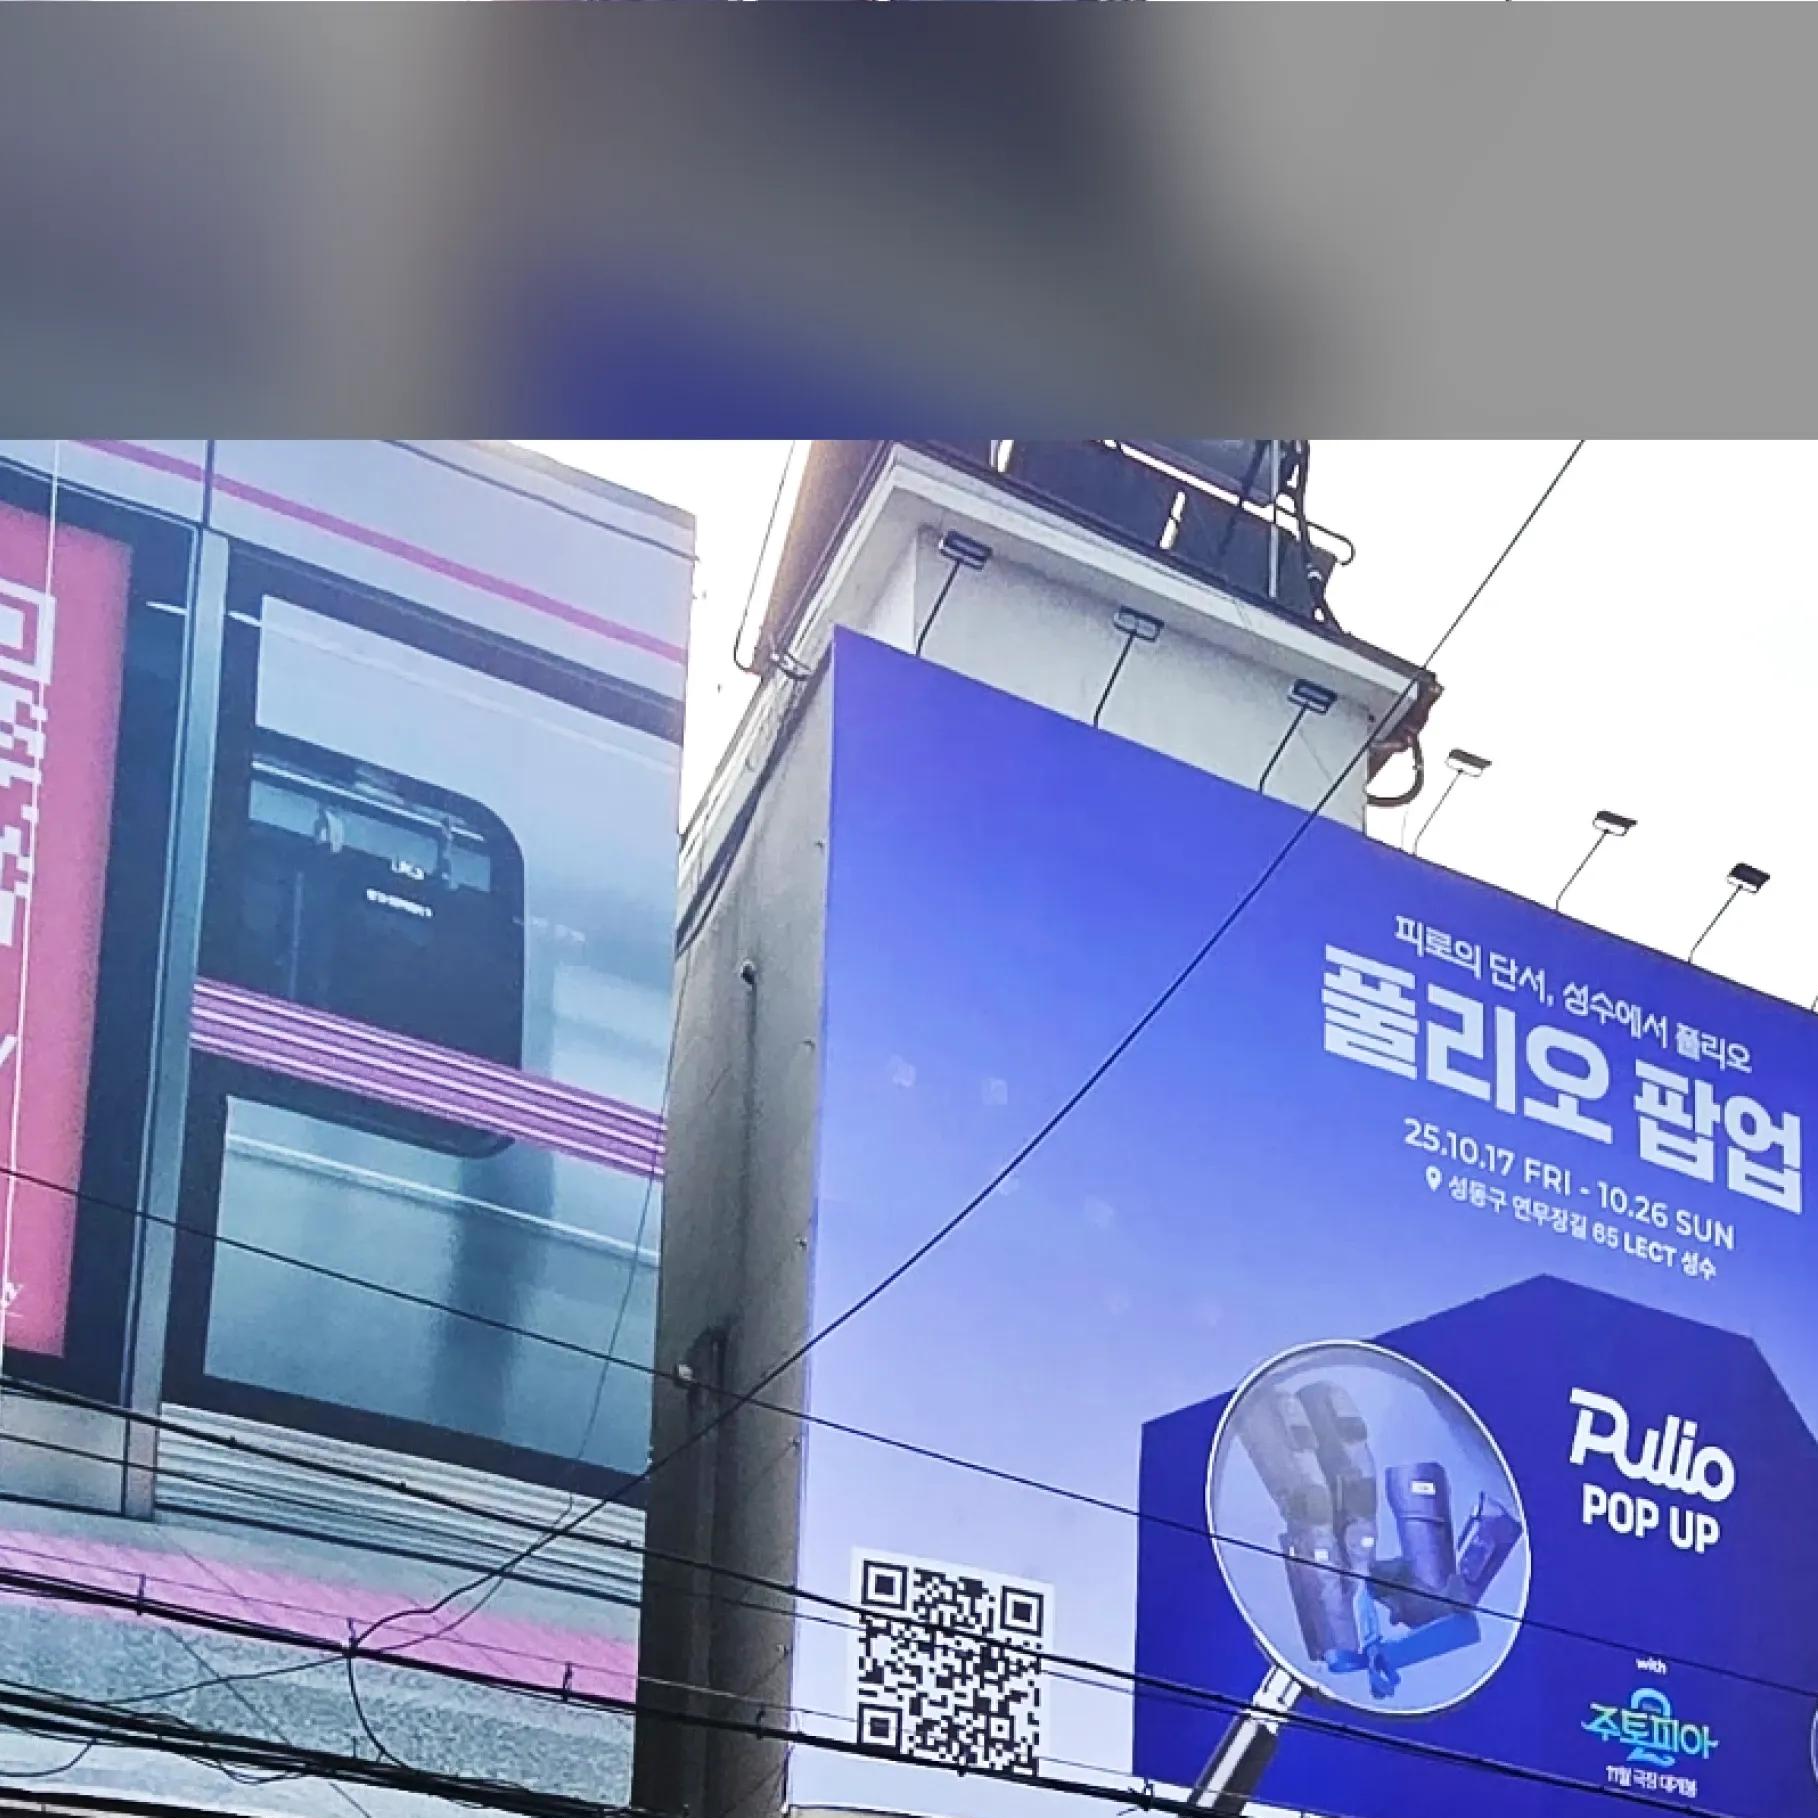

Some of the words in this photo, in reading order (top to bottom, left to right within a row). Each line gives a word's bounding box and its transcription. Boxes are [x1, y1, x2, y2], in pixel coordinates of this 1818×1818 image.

[1395, 914, 1483, 979] 피로의
[1488, 952, 1555, 1006] 단서,
[1562, 981, 1669, 1050] 성수에서
[1675, 1021, 1753, 1074] 풀리오
[1322, 943, 1614, 1146] 풀리오
[1633, 1058, 1803, 1216] 팝업
[1403, 1117, 1515, 1177] 25.10.17
[1523, 1157, 1571, 1196] FRI
[1597, 1180, 1669, 1230] 10.26
[1675, 1209, 1735, 1251] SUN
[1448, 1174, 1507, 1214] 성동구
[1512, 1194, 1588, 1241] 연무장길
[1623, 1231, 1678, 1268] LECT
[1681, 1251, 1717, 1281] 성수
[1569, 1387, 1736, 1502] Pulio
[1581, 1482, 1660, 1538] POP
[1668, 1504, 1721, 1554] UP
[1581, 1701, 1721, 1761] 주토피아
